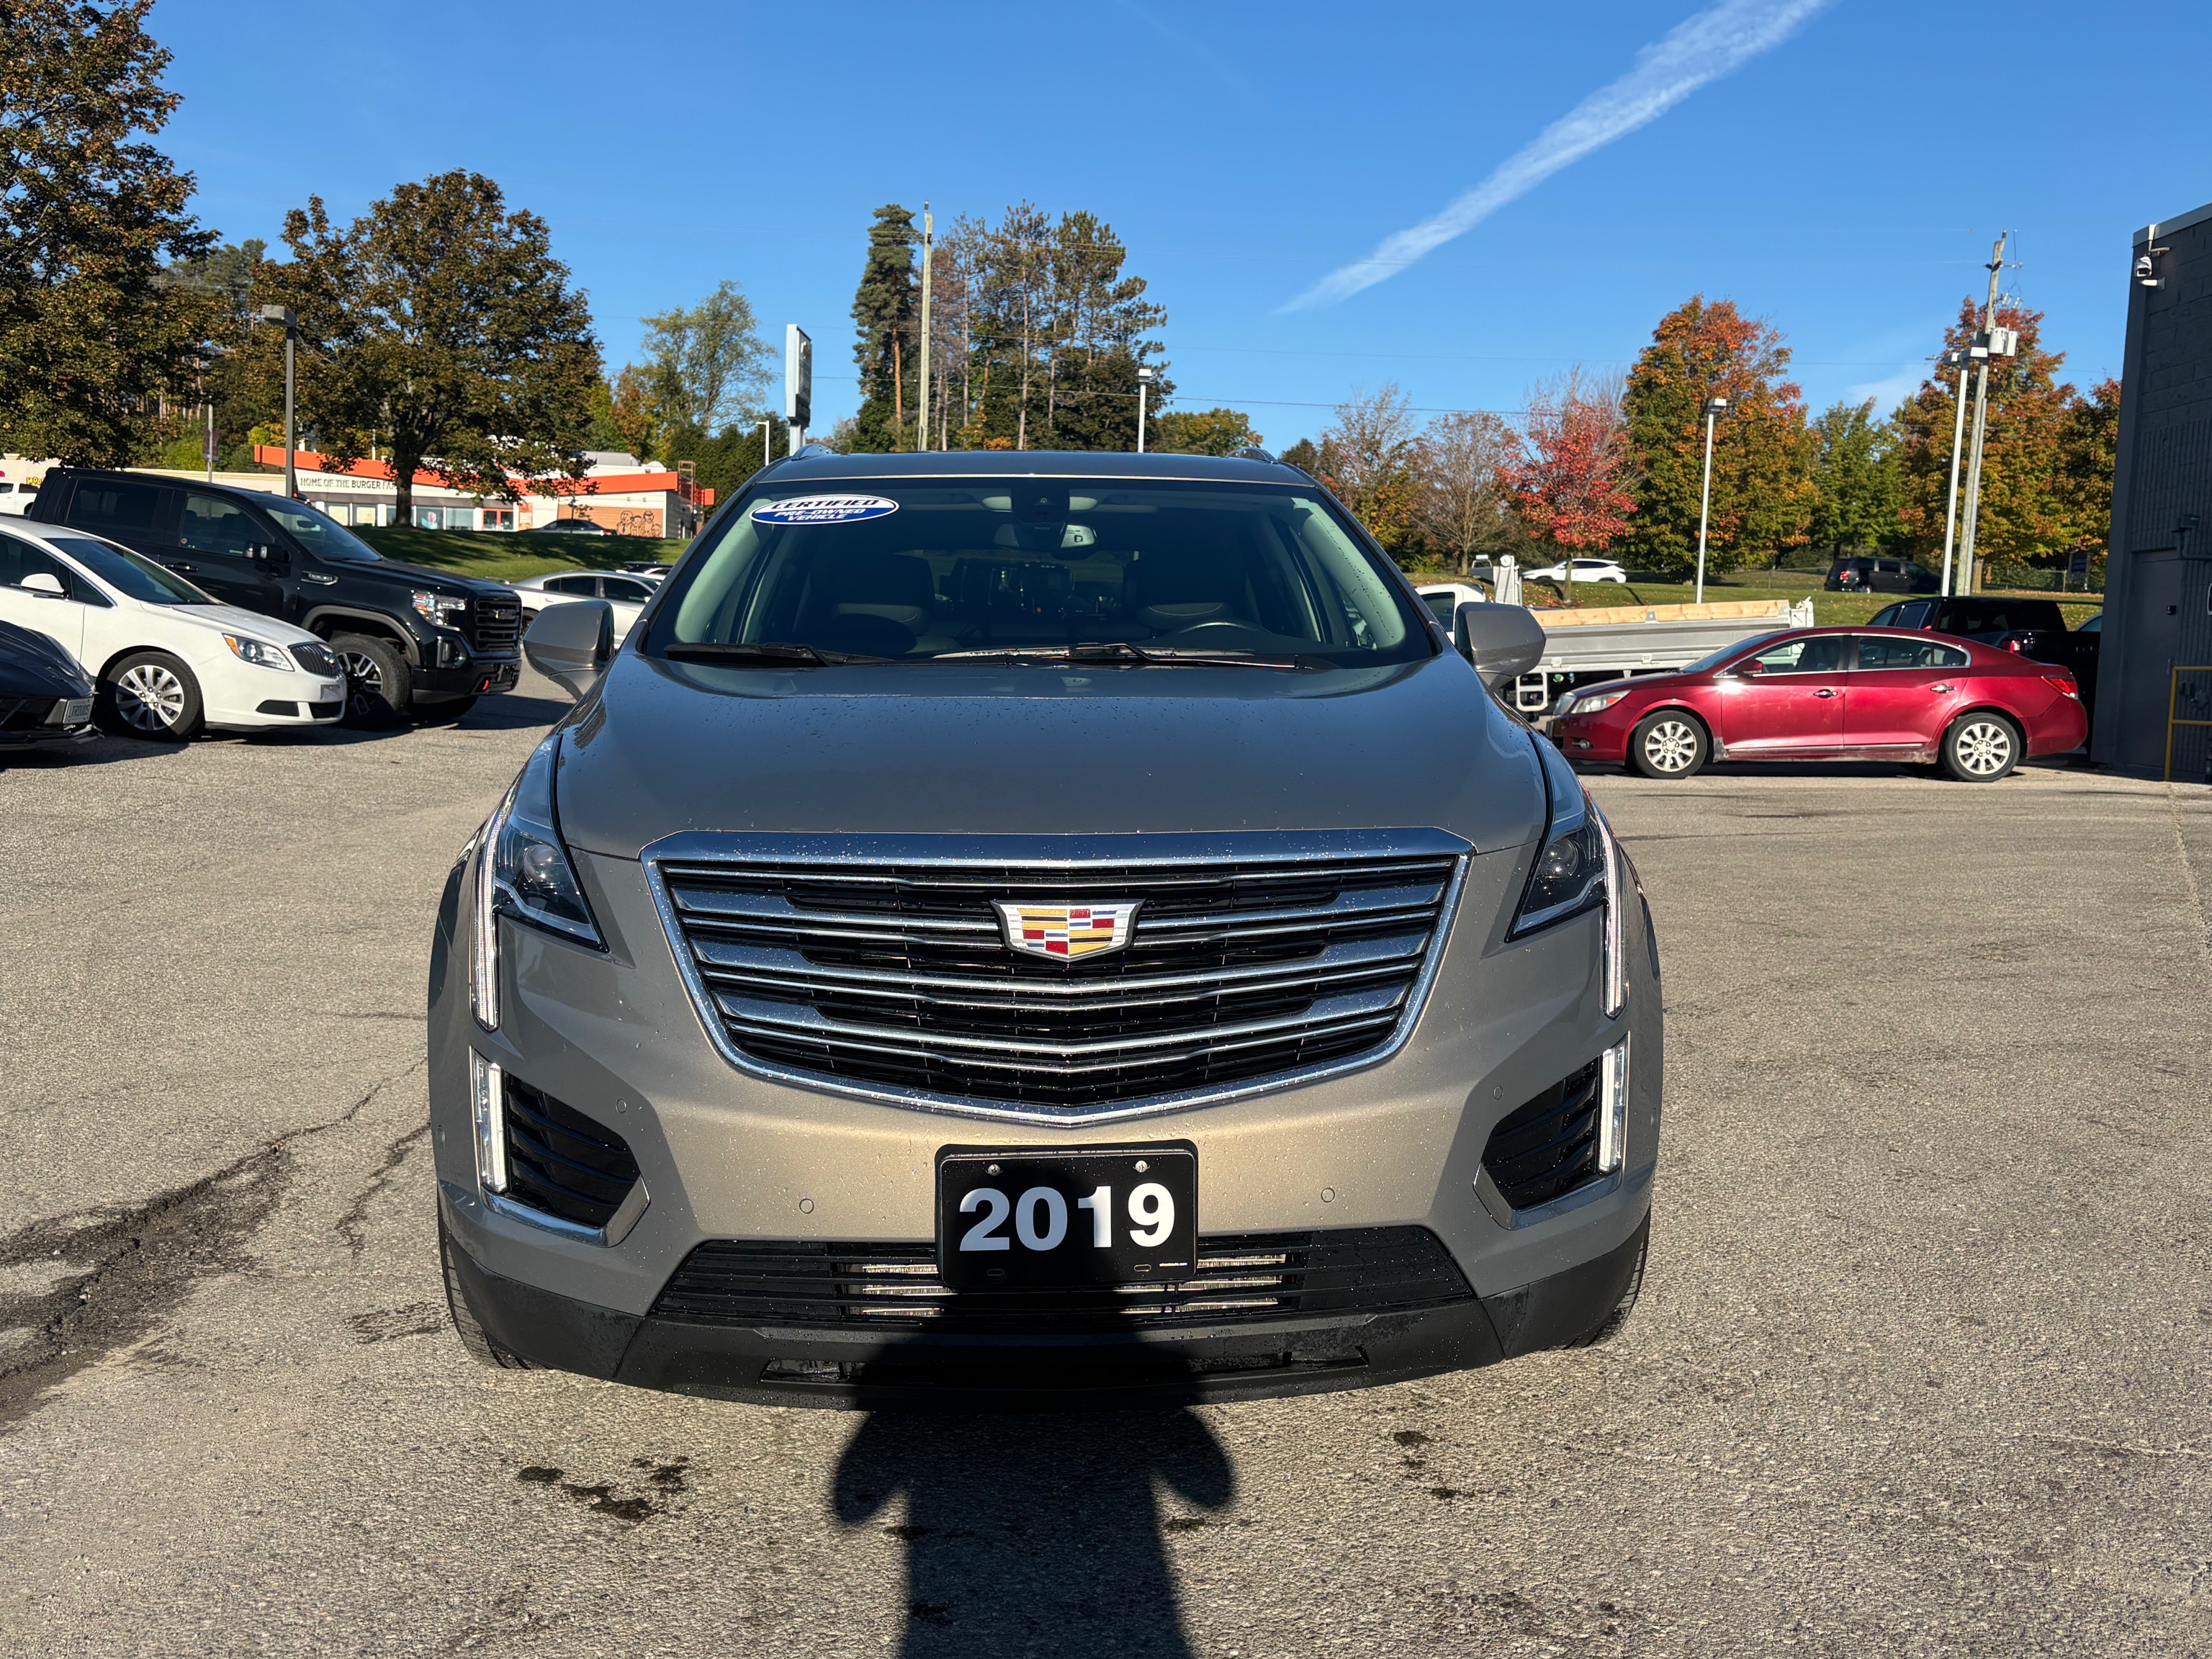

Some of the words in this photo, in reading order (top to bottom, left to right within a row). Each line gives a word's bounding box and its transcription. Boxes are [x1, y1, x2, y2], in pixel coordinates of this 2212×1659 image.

[300, 477, 322, 487] HOME
[323, 479, 333, 487] OF
[336, 479, 350, 488] THE
[351, 480, 381, 490] BURGER
[771, 500, 880, 510] CERTIFIED
[774, 508, 866, 518] PRE-OWNED
[959, 1182, 1175, 1251] 2019
